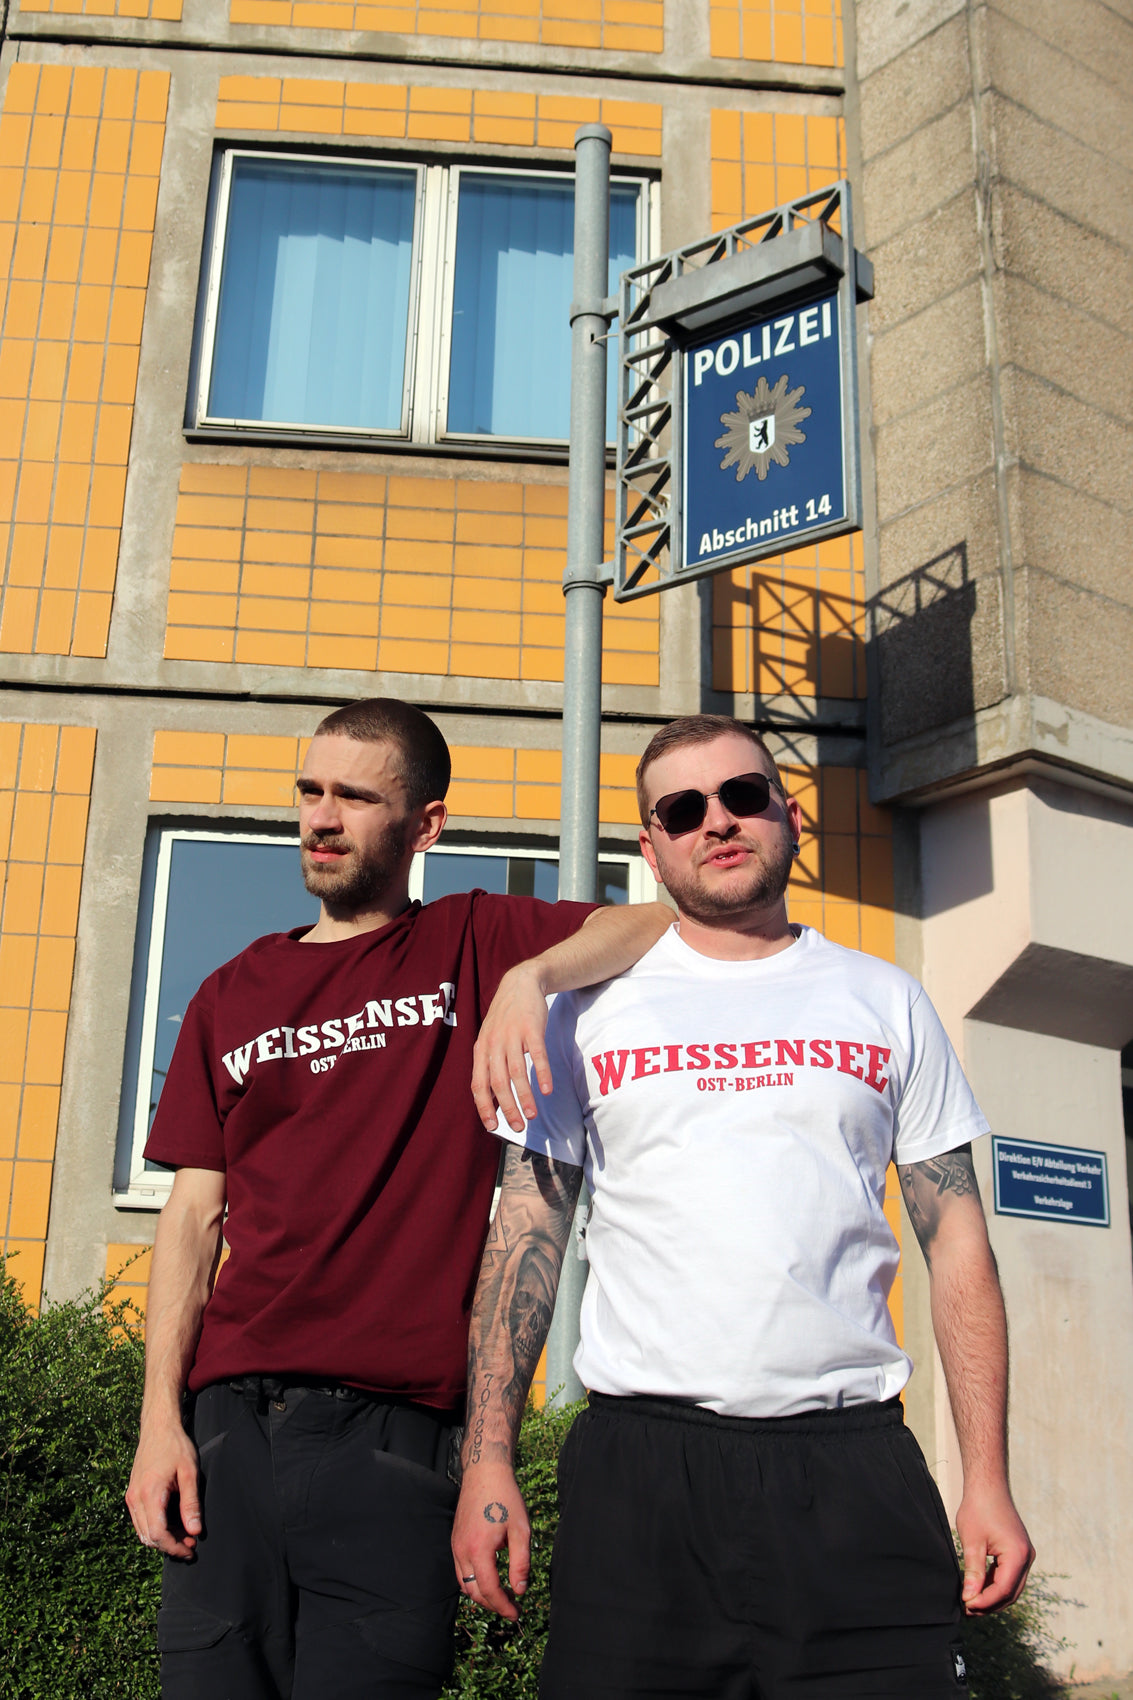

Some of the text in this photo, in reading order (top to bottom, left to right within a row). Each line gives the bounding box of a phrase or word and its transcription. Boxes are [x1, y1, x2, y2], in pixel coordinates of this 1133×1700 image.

[694, 301, 832, 387] POLIZEI
[699, 493, 832, 556] Abschnitt 14
[222, 981, 458, 1086] WEISSENSEE
[591, 1039, 892, 1095] WEISSENSEE
[696, 1072, 794, 1092] OST-BERLIN
[998, 1151, 1031, 1166] Direktion
[1044, 1158, 1076, 1174] Abteilung
[1076, 1163, 1102, 1175] Verkehr
